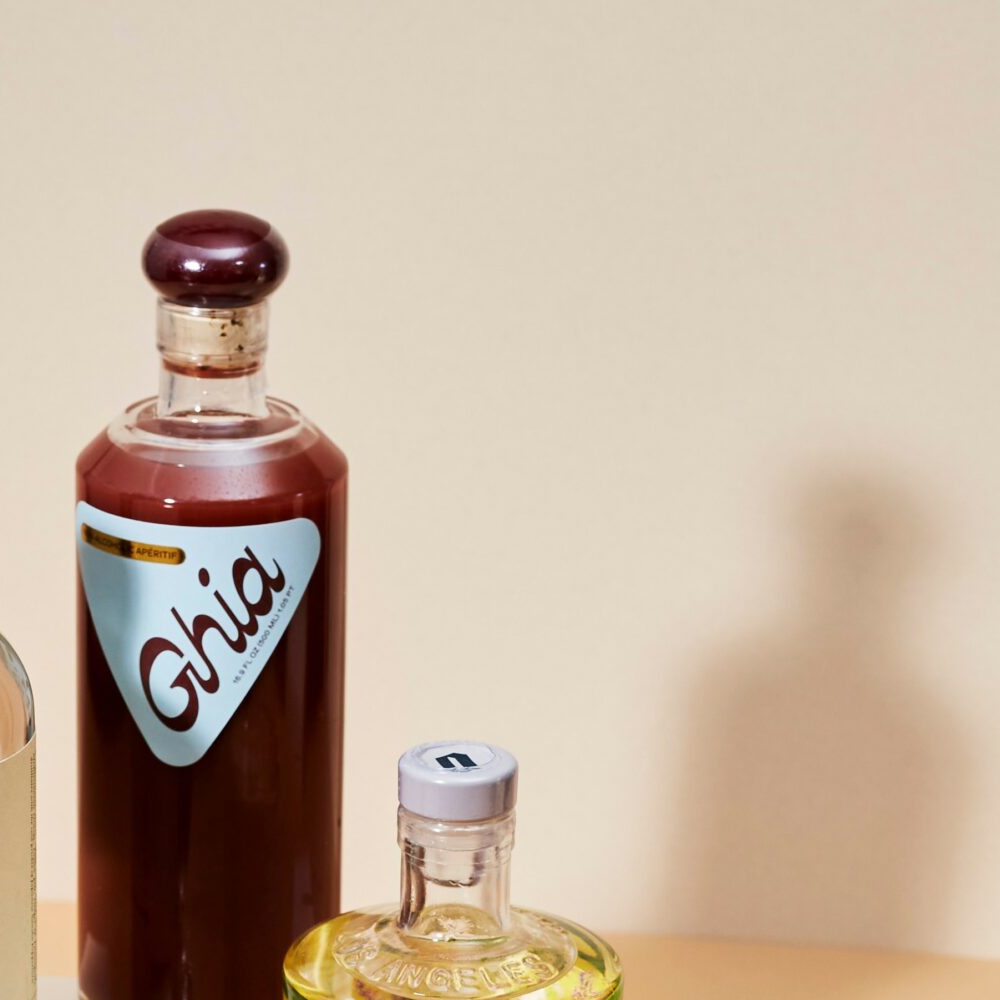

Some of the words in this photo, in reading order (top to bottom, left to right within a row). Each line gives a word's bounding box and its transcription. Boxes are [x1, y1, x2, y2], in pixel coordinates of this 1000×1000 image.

[139, 545, 286, 733] Ghia
[249, 646, 260, 659] OZ
[362, 951, 560, 994] ANGELES
